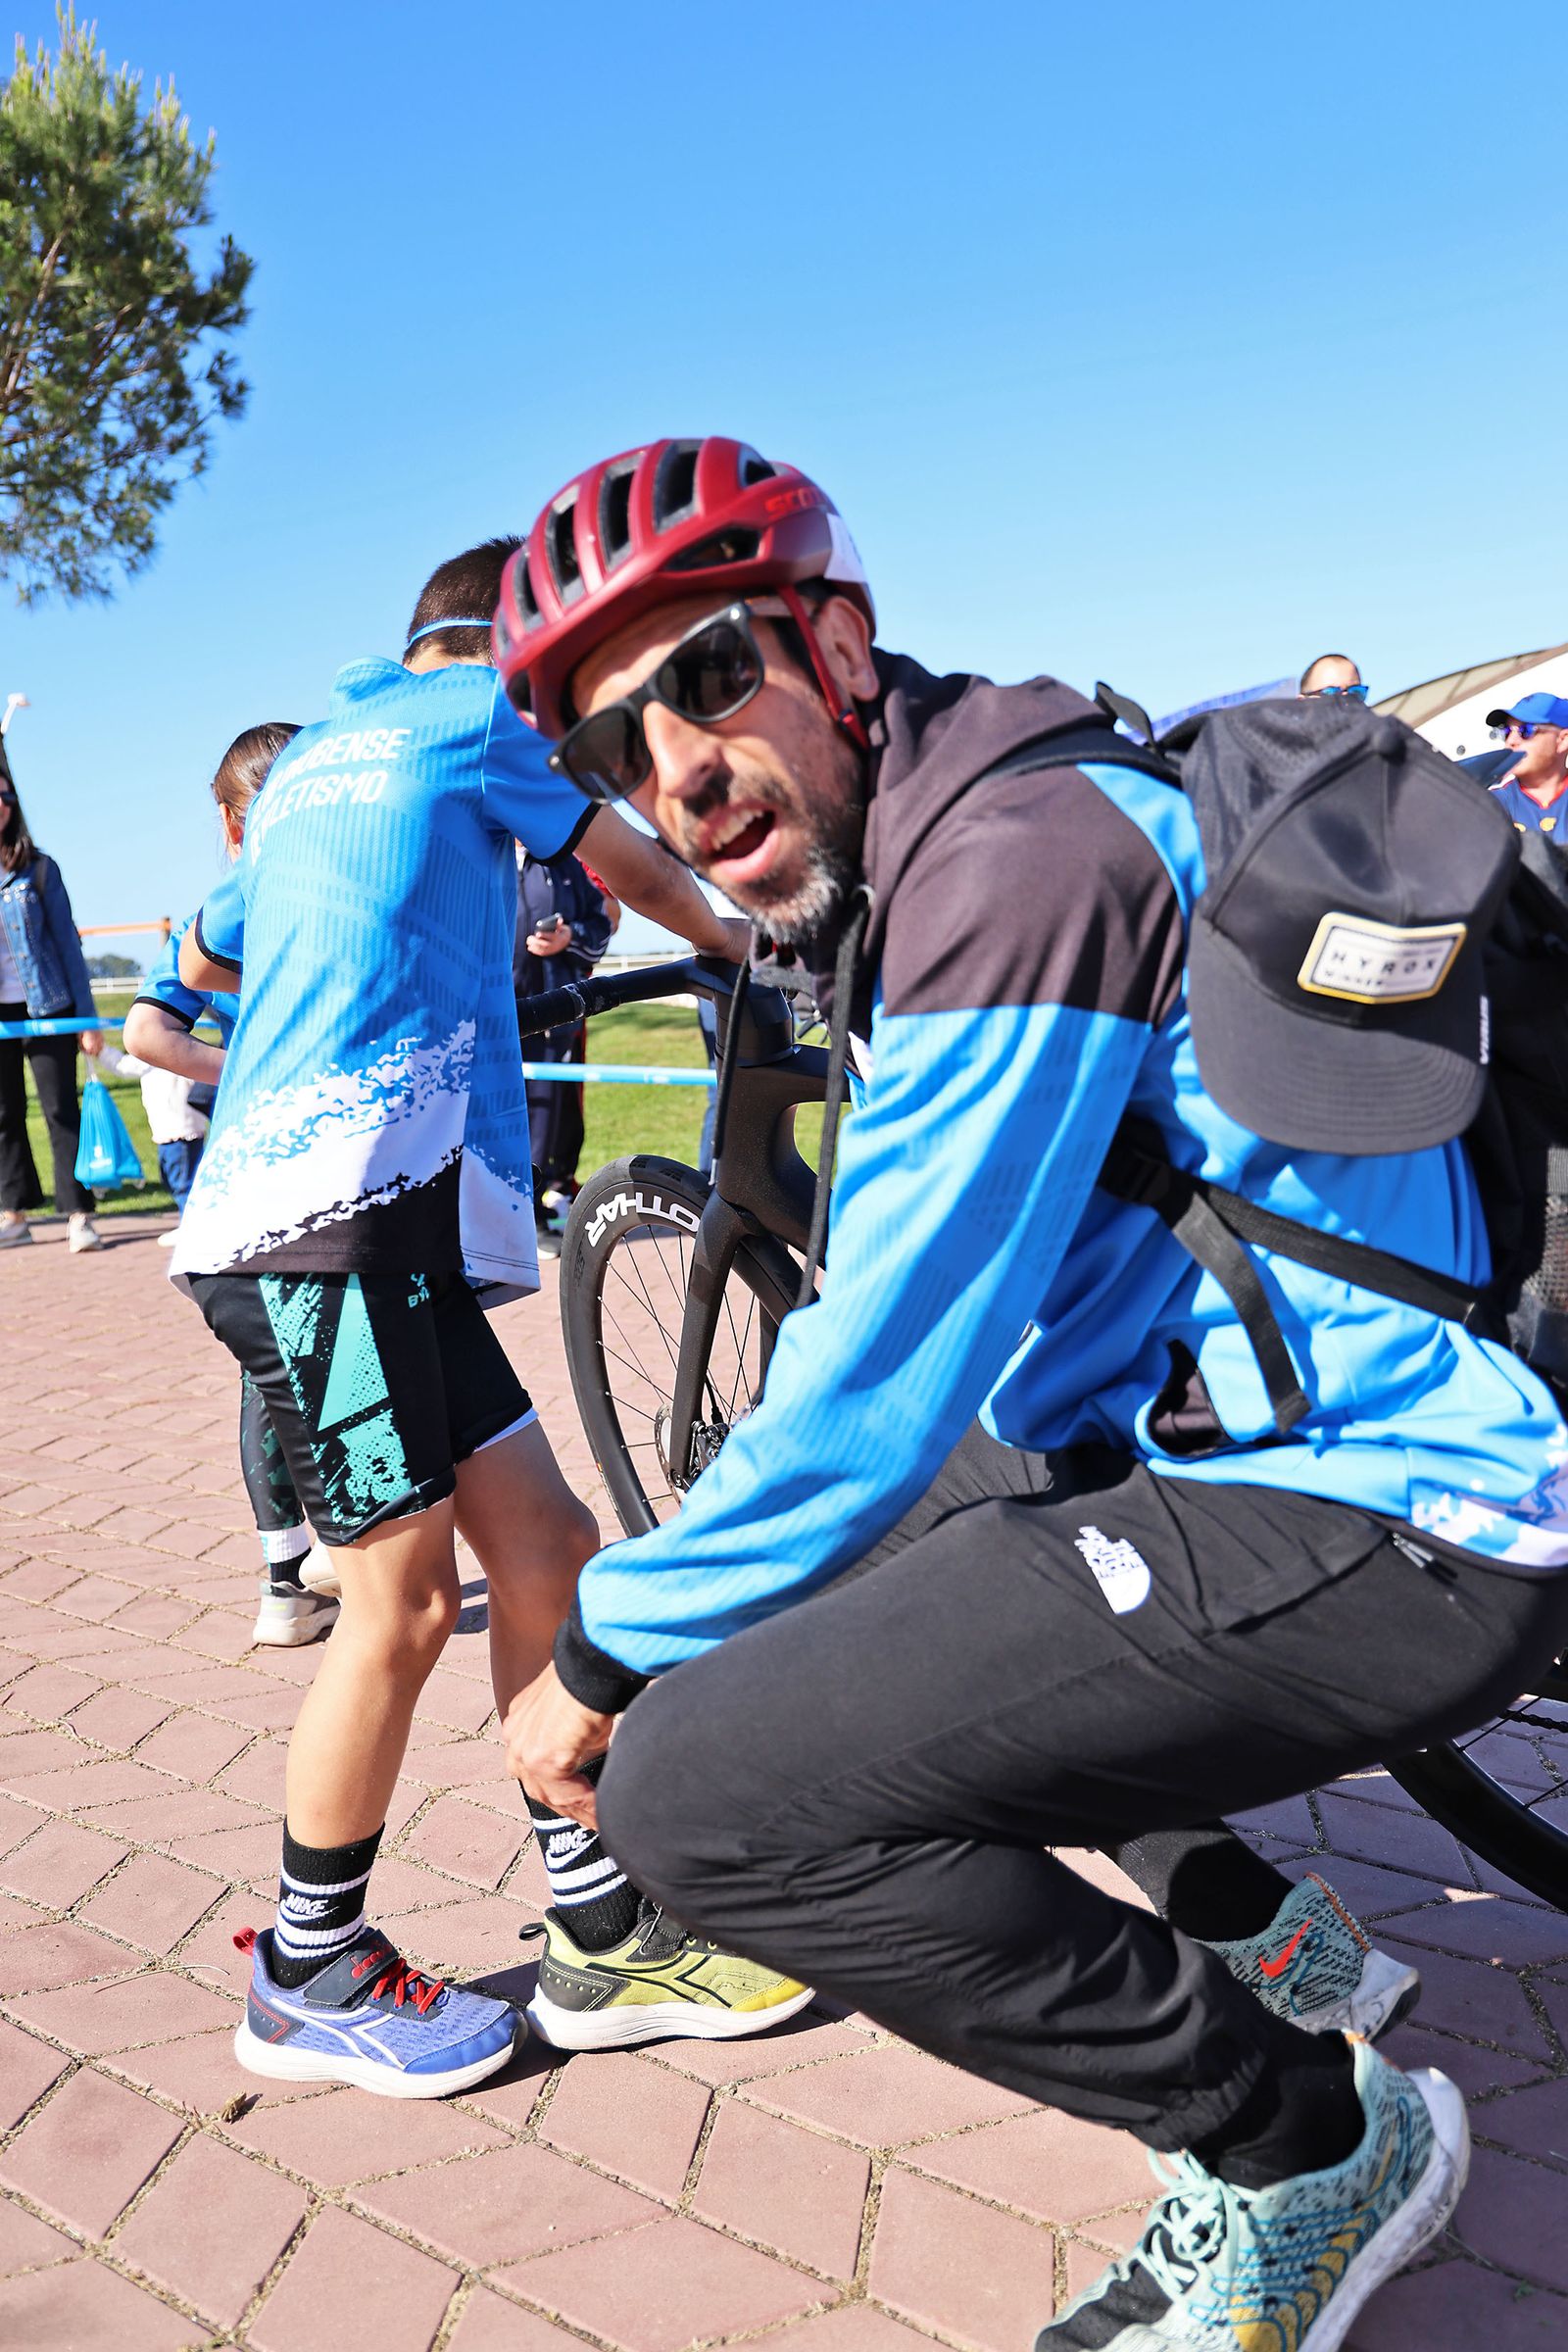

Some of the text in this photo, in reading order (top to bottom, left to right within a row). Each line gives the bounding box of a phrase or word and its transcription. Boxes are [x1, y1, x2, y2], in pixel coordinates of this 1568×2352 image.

[764, 487, 825, 521] SCO
[549, 1828, 588, 1854] NIKE
[284, 1892, 328, 1915] NIKE
